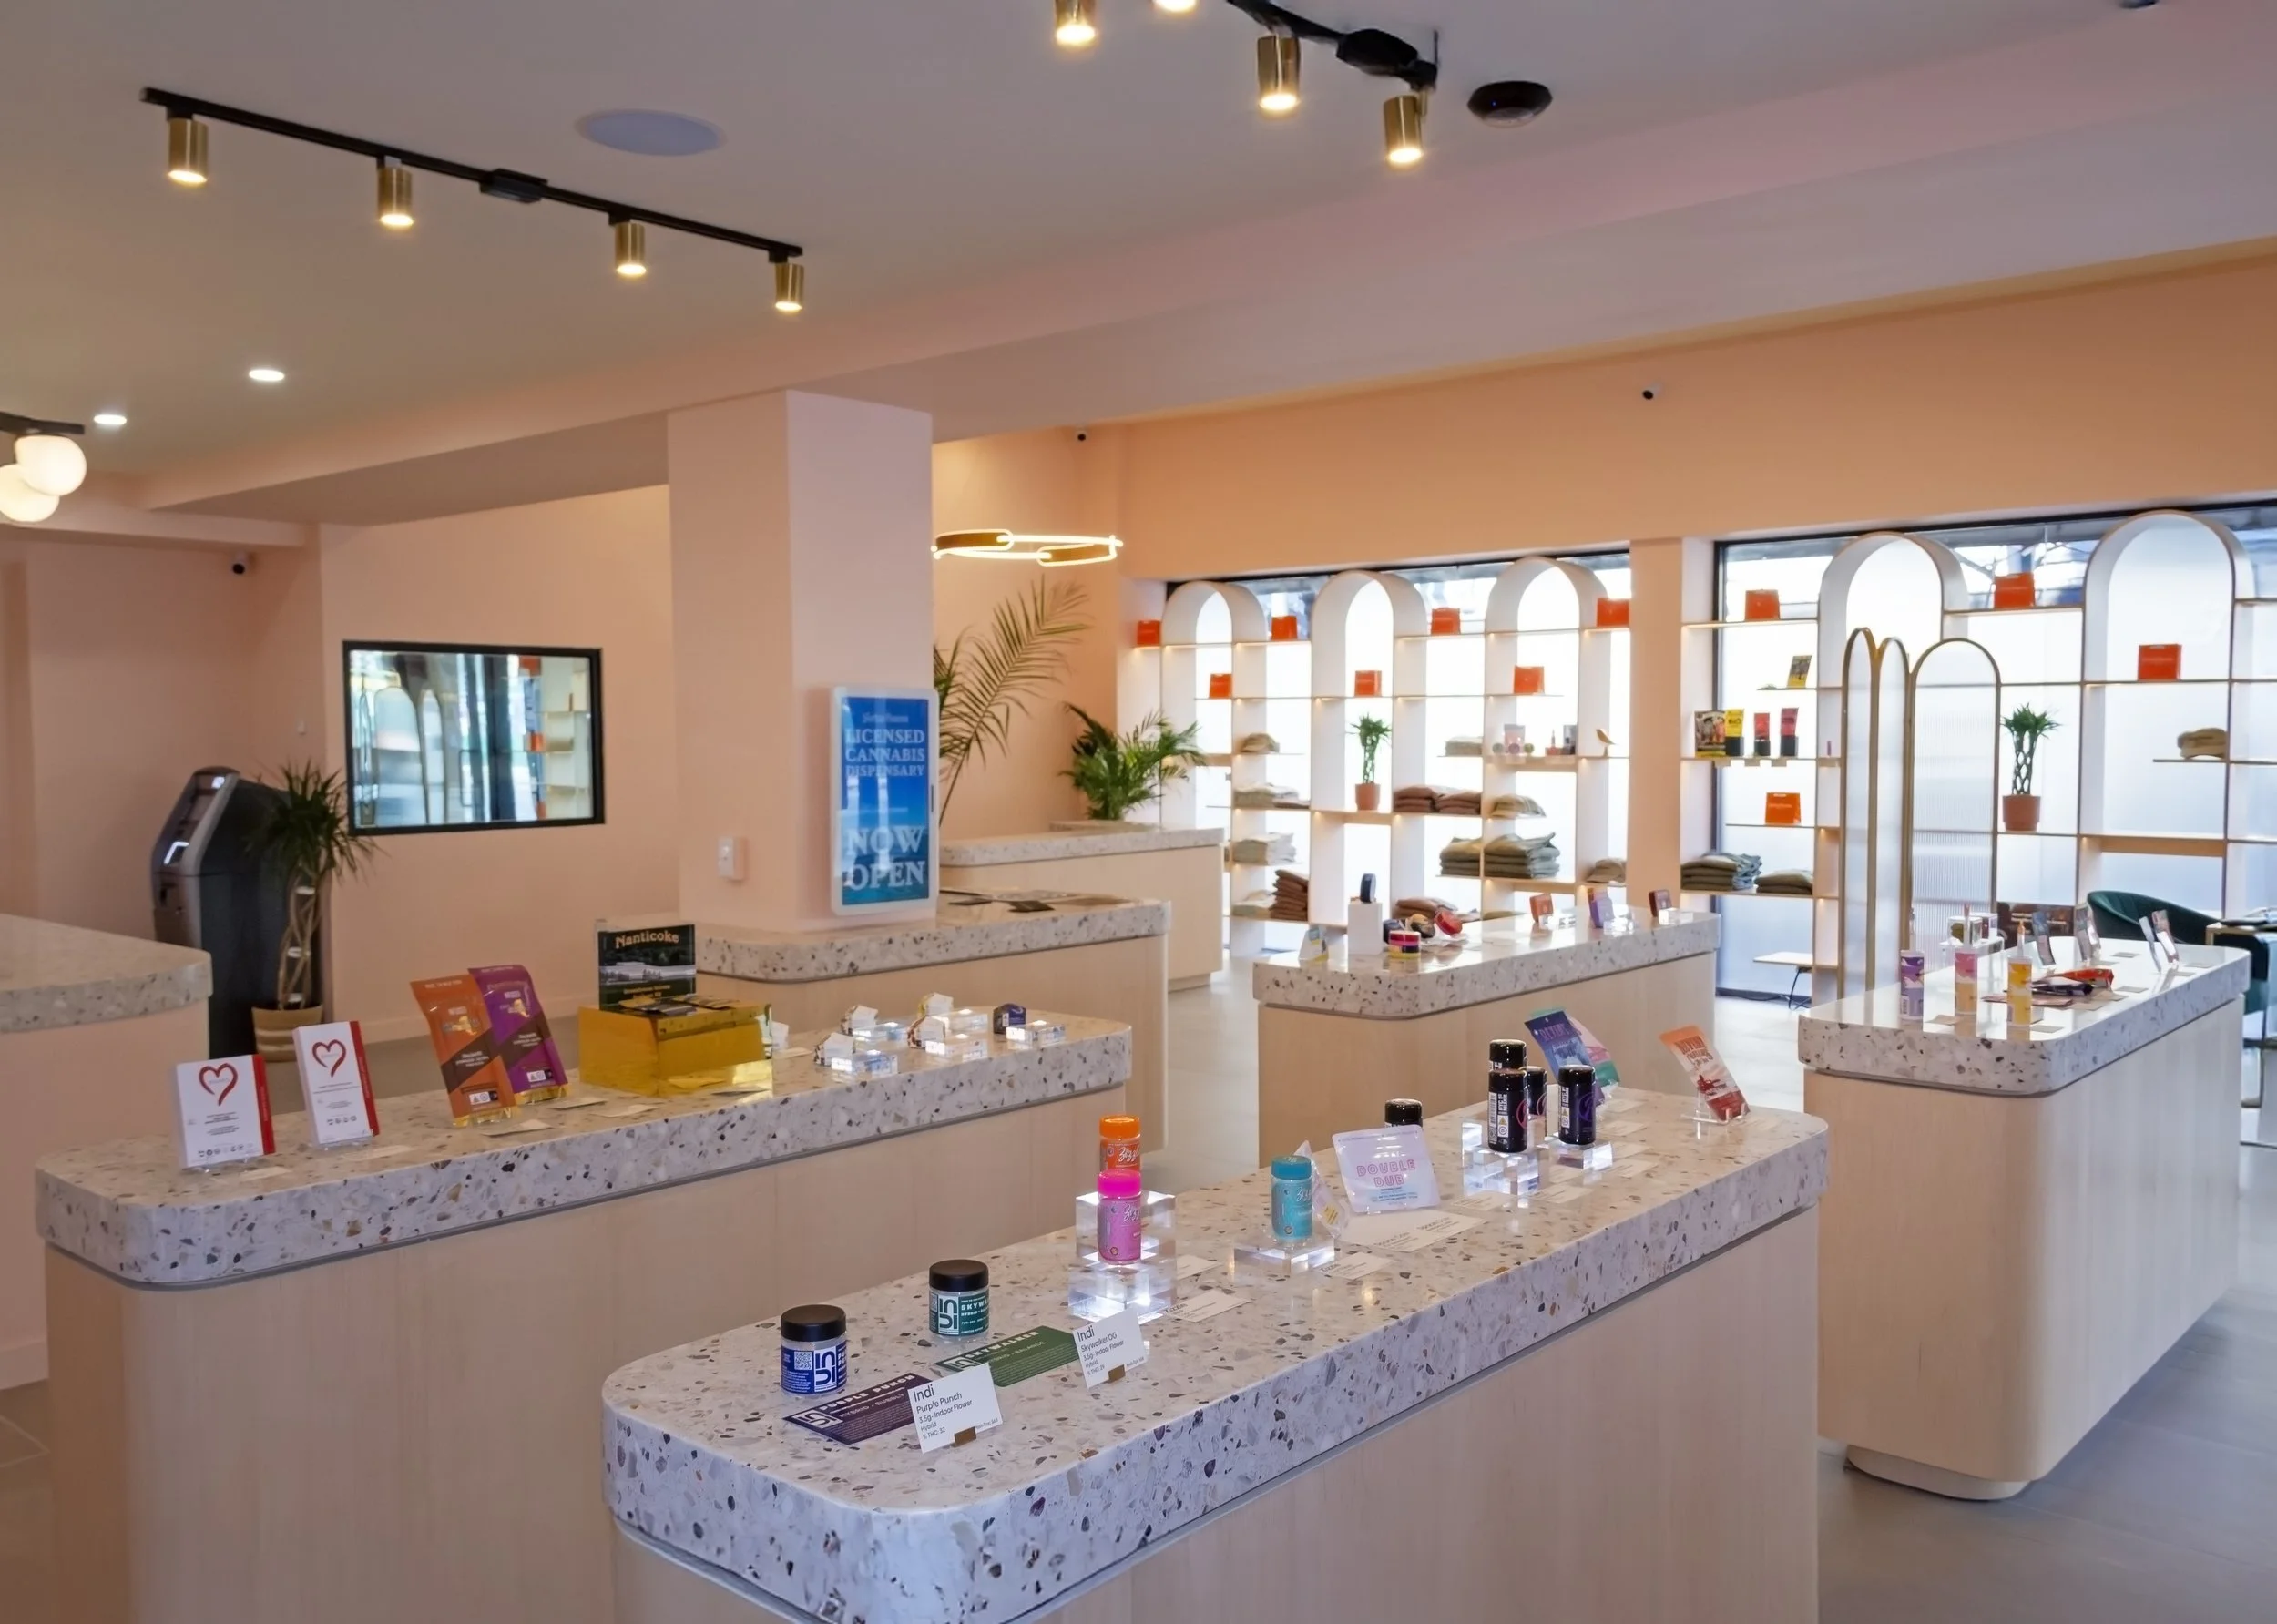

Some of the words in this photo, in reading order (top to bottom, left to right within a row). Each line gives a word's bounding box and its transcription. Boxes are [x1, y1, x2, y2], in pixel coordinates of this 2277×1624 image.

[845, 729, 924, 744] LICENSED
[845, 748, 924, 762] CANNABIS
[845, 764, 924, 777] DISPENSARY
[846, 825, 925, 856] NOW
[849, 860, 925, 891] OPEN
[615, 930, 679, 949] Nanticoke
[1356, 1159, 1416, 1177] DOUBLE
[1373, 1174, 1404, 1188] DUB
[1077, 1325, 1095, 1342] Indi
[1080, 1337, 1108, 1353] Skywalker
[1108, 1332, 1118, 1342] OG
[965, 1331, 1039, 1358] SKYWALKER
[1109, 1340, 1124, 1351] Flower
[820, 1393, 869, 1411] PURPLE
[873, 1374, 915, 1393] PUNCH
[913, 1384, 934, 1403] Indi
[916, 1399, 939, 1414] Purple
[939, 1392, 962, 1405] Punch
[934, 1407, 953, 1418] Indoor
[954, 1400, 973, 1410] Flower
[920, 1422, 937, 1432] Hybrid
